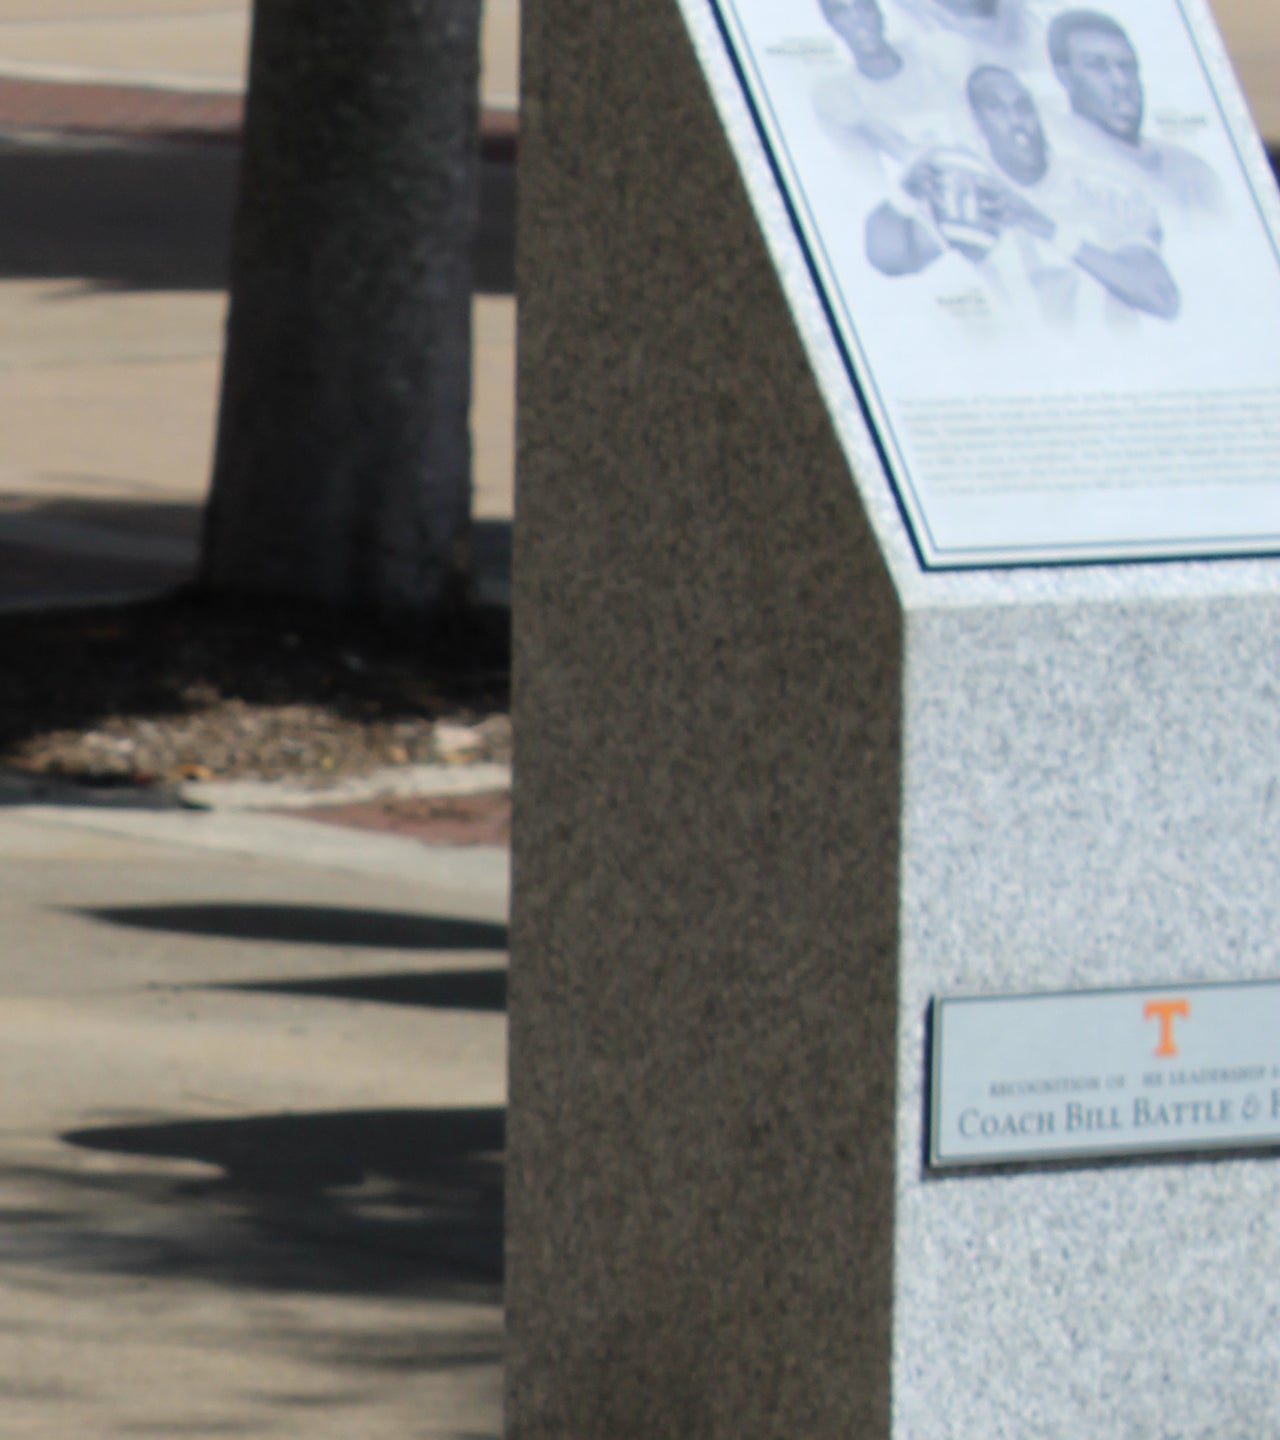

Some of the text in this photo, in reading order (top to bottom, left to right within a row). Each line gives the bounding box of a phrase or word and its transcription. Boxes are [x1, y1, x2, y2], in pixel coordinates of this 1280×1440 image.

[1143, 998, 1190, 1057] T
[957, 1107, 1055, 1138] COACH
[1065, 1101, 1123, 1133] BILL
[1133, 1096, 1232, 1129] BATTLE
